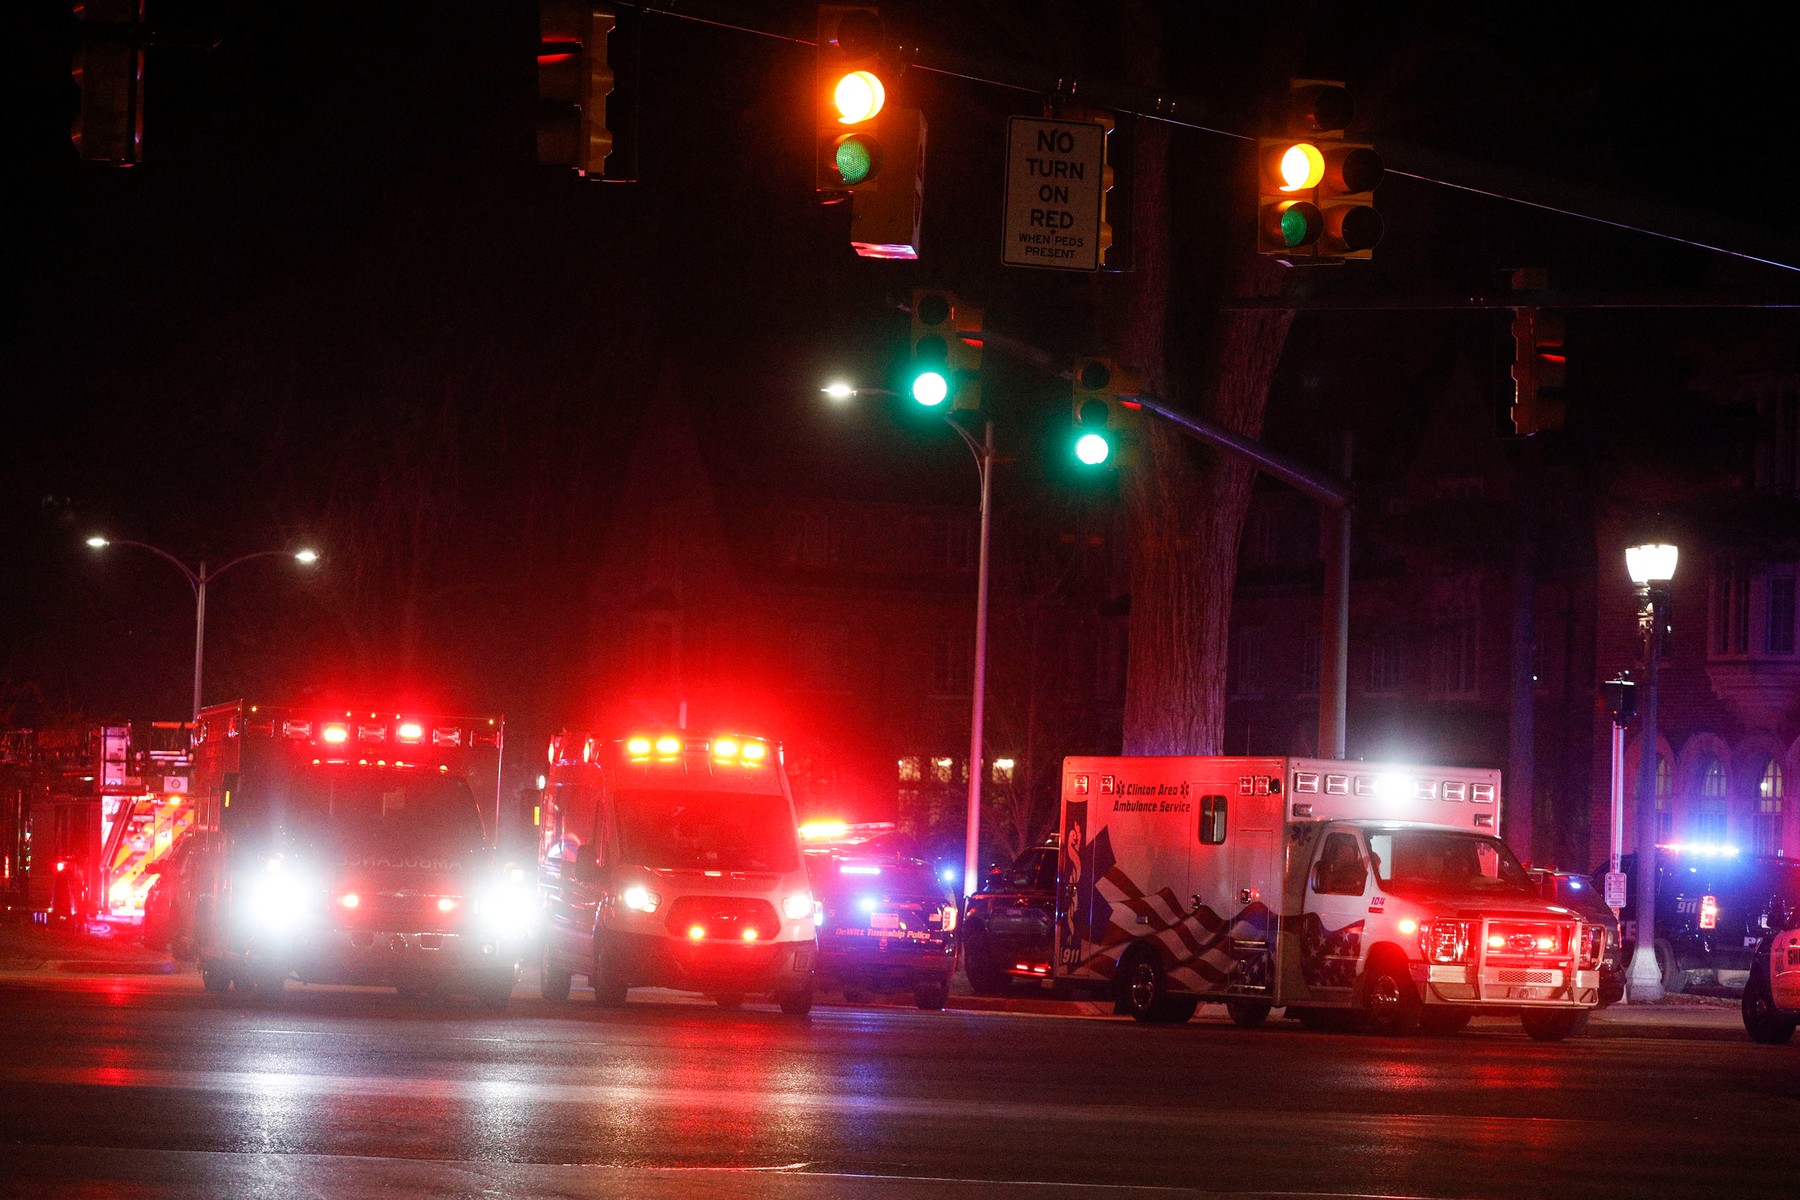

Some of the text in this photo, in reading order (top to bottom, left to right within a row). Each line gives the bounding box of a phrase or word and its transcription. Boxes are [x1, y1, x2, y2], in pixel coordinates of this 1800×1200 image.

[1037, 129, 1075, 154] NO
[1026, 158, 1084, 180] TURN
[1038, 184, 1069, 204] ON
[1030, 208, 1074, 229] RED
[1018, 233, 1084, 247] WHEN PEDS
[1025, 246, 1076, 259] PRESENT
[1127, 783, 1178, 796] Clinton Area
[1112, 800, 1191, 812] Ambulance Service
[1370, 896, 1386, 906] 104
[1677, 901, 1697, 913] 911
[835, 927, 931, 940] DeWitt Township Police
[1062, 948, 1080, 964] 911
